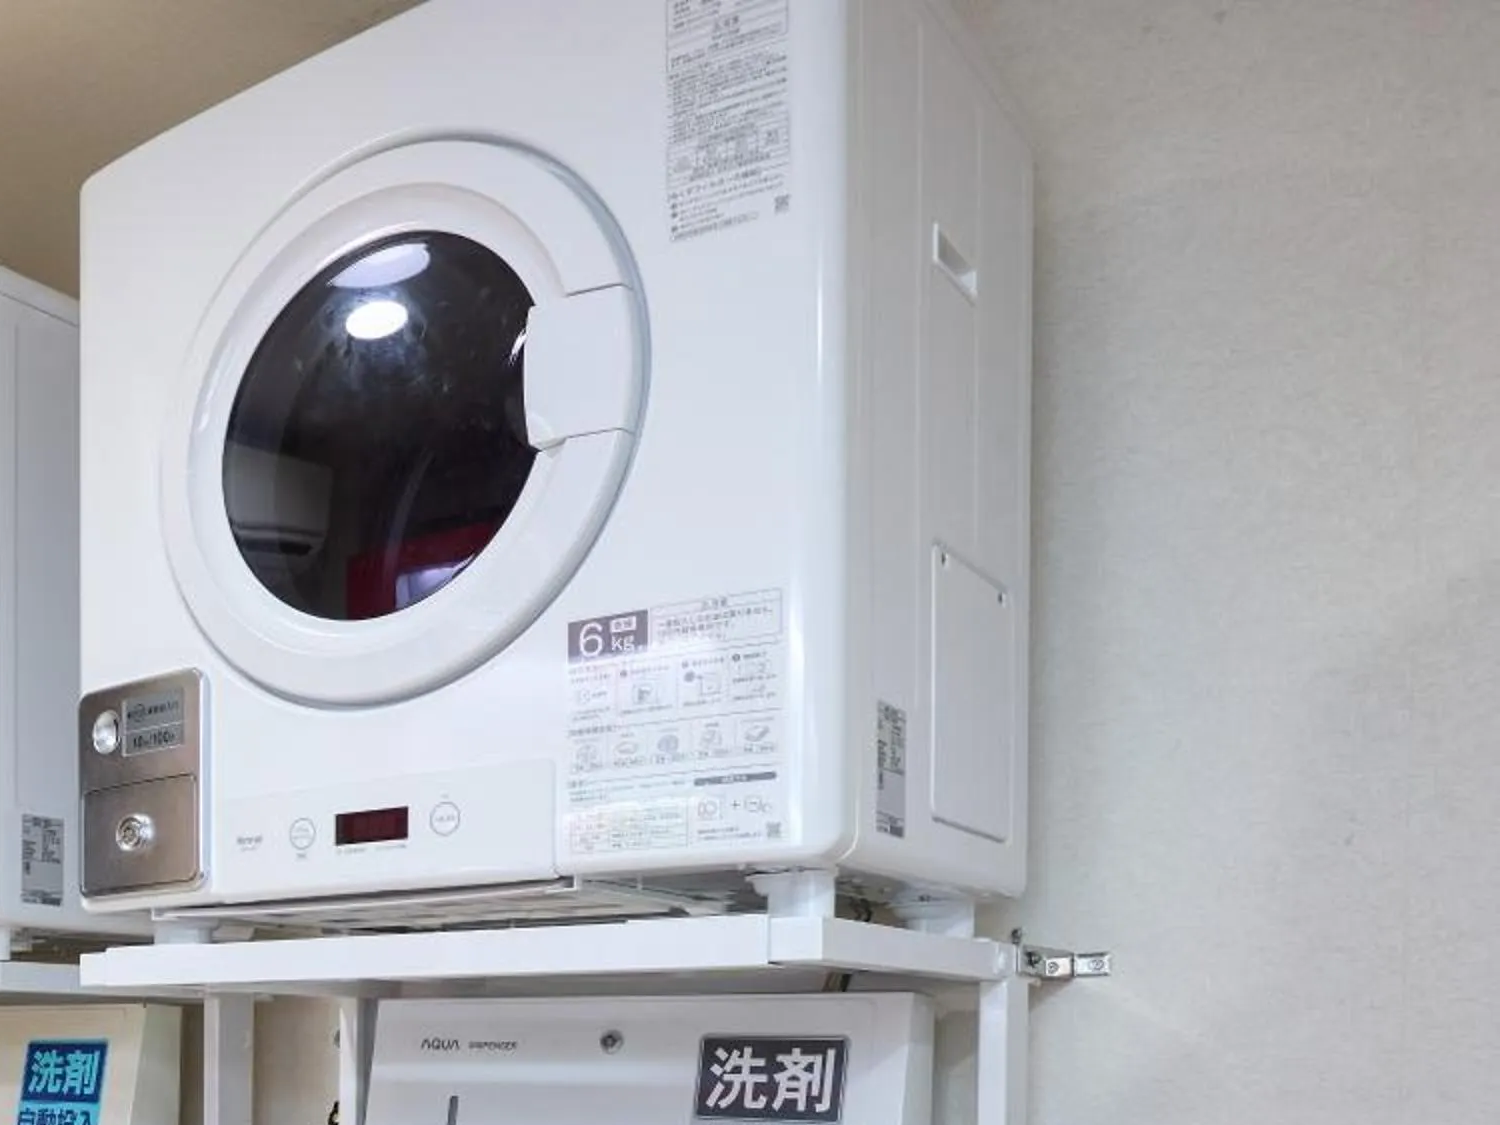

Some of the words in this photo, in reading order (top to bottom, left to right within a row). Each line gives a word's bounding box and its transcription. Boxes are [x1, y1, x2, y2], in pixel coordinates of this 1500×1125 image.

[578, 621, 603, 657] 6
[421, 1037, 460, 1051] AQUA
[28, 1050, 100, 1096] 洗剤
[705, 1047, 836, 1113] 洗剤
